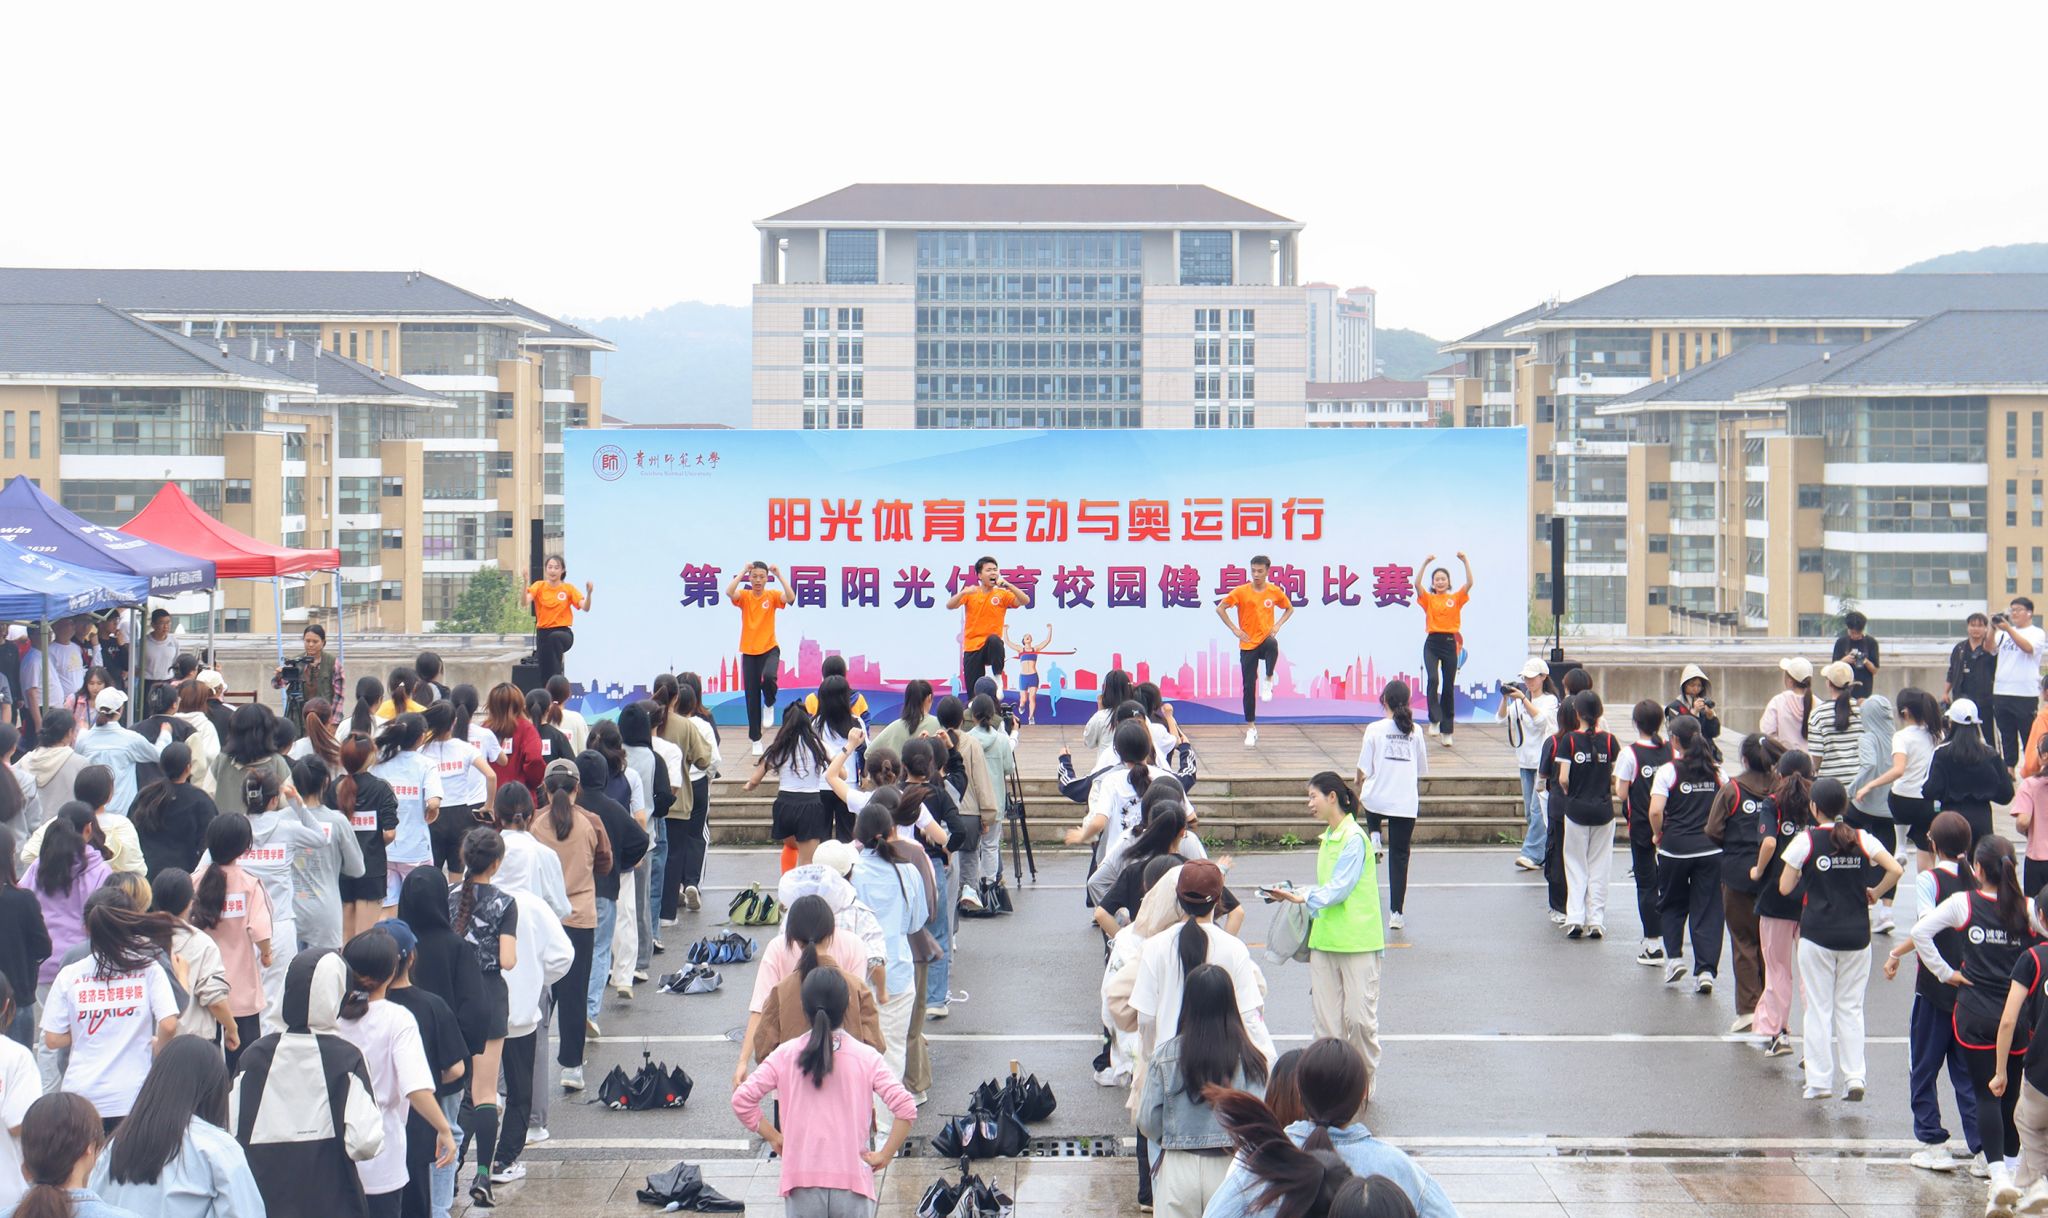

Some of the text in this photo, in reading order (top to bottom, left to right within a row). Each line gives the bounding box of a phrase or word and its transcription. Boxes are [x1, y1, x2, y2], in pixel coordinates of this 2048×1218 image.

[768, 497, 1325, 542] 阳光体育运动与奥运同行
[680, 562, 1415, 609] 第届阳光体育校园健身跑比赛
[78, 985, 143, 1003] 经济与管理学院
